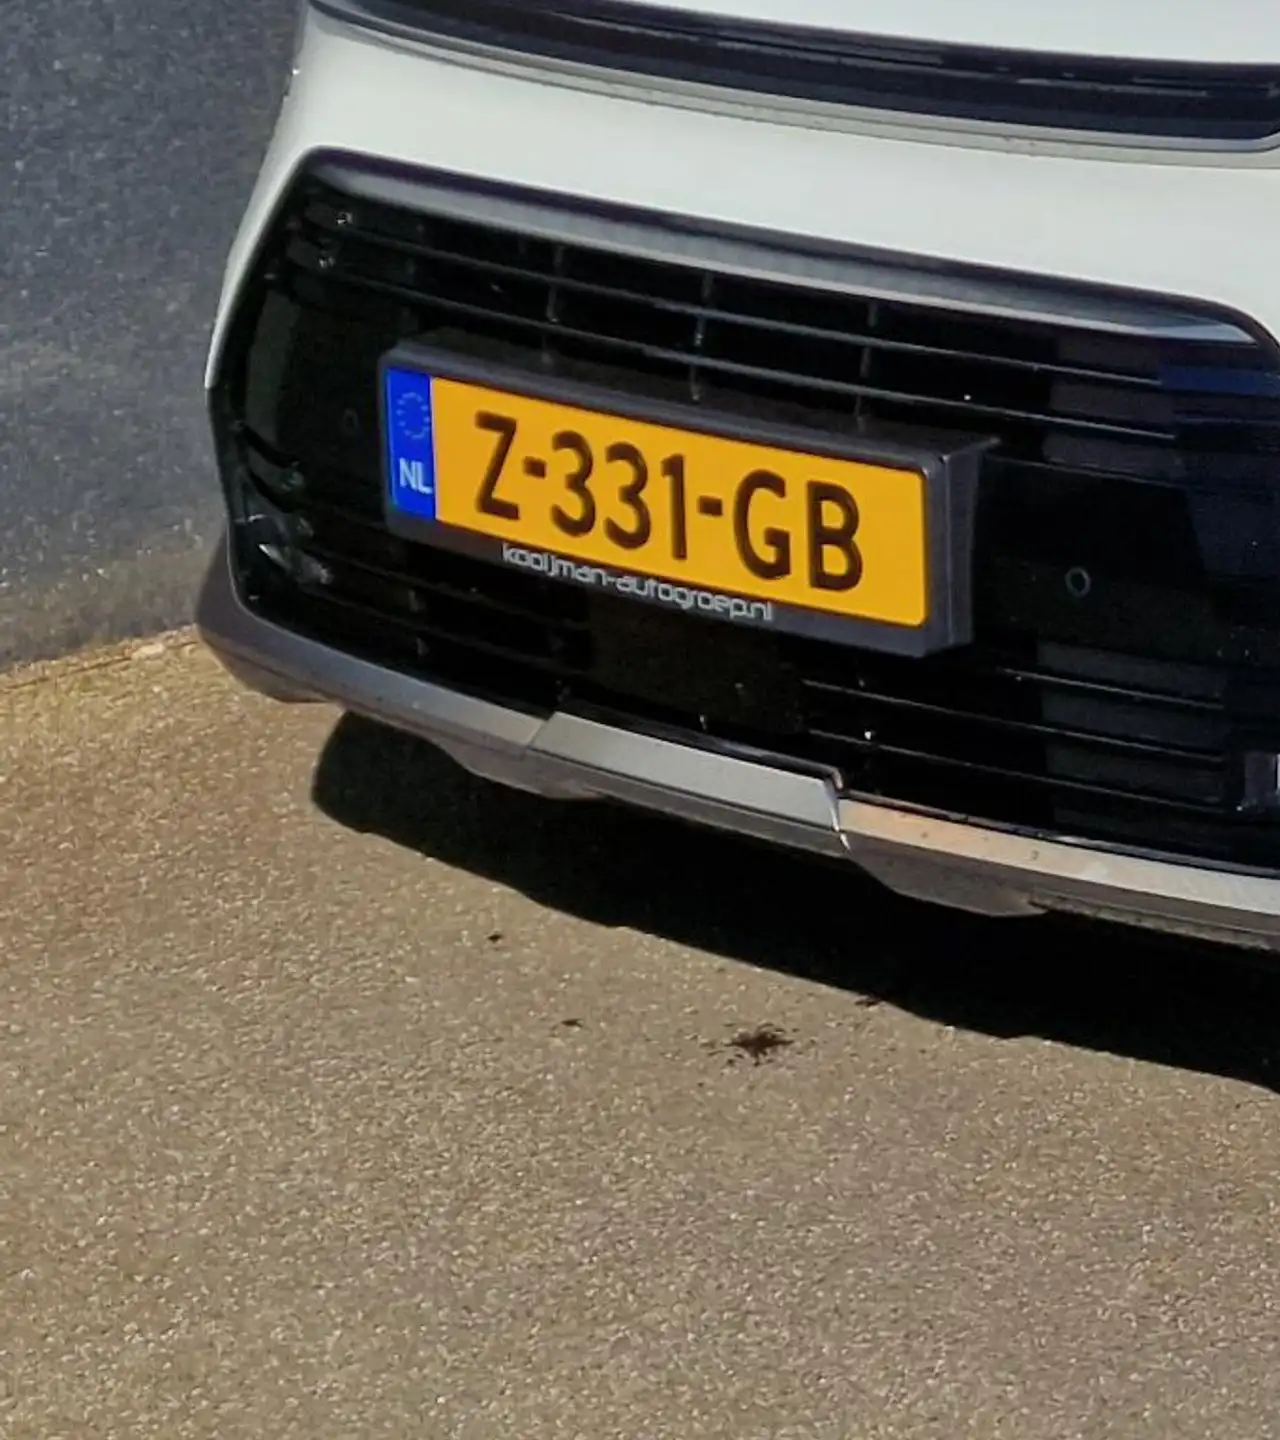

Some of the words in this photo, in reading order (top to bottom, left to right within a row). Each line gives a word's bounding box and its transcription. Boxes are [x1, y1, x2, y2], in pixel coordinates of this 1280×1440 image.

[399, 457, 433, 494] NL
[474, 410, 863, 592] Z-331-GB
[502, 543, 774, 622] kooijman-autogroep.nl
